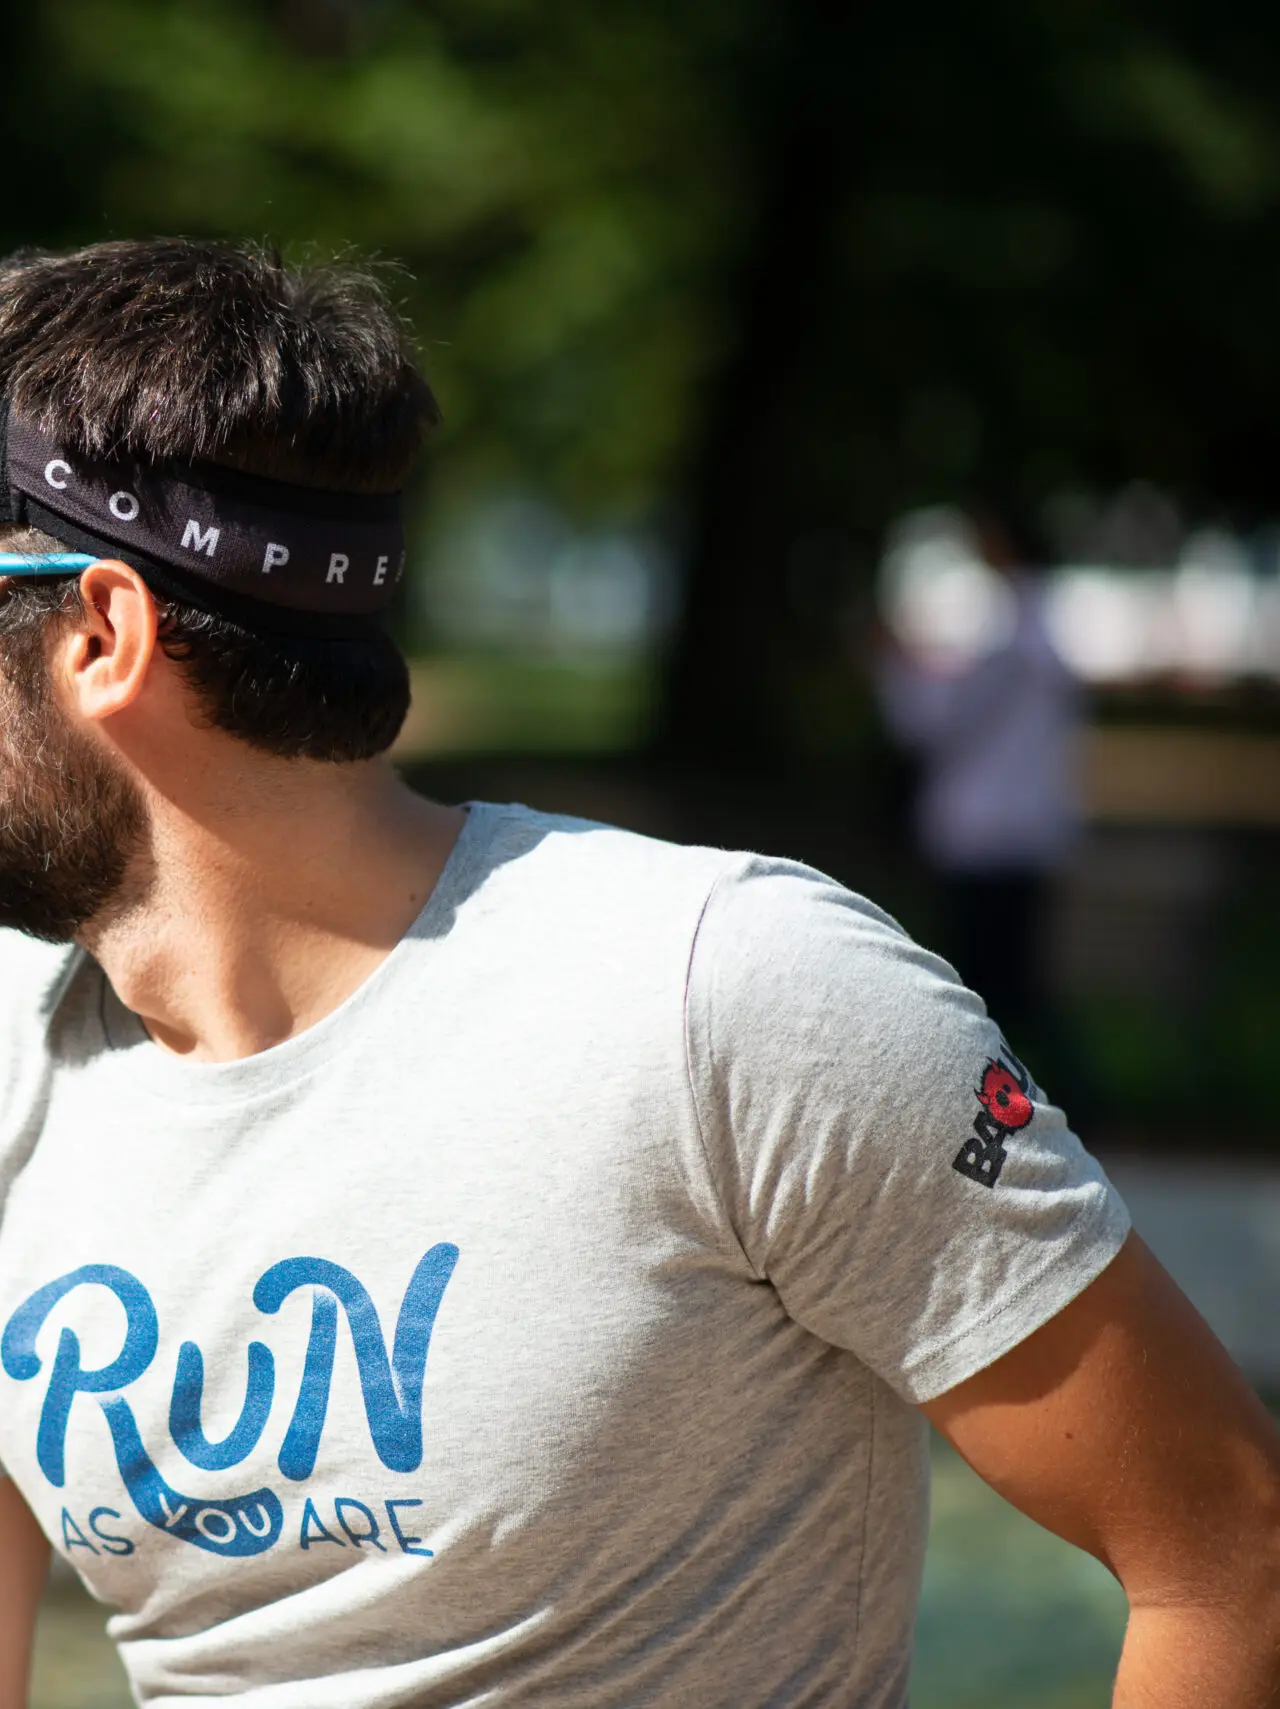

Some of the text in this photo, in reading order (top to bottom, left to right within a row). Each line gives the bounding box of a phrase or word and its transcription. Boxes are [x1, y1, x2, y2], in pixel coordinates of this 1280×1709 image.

[61, 1492, 434, 1557] AS YOU ARE
